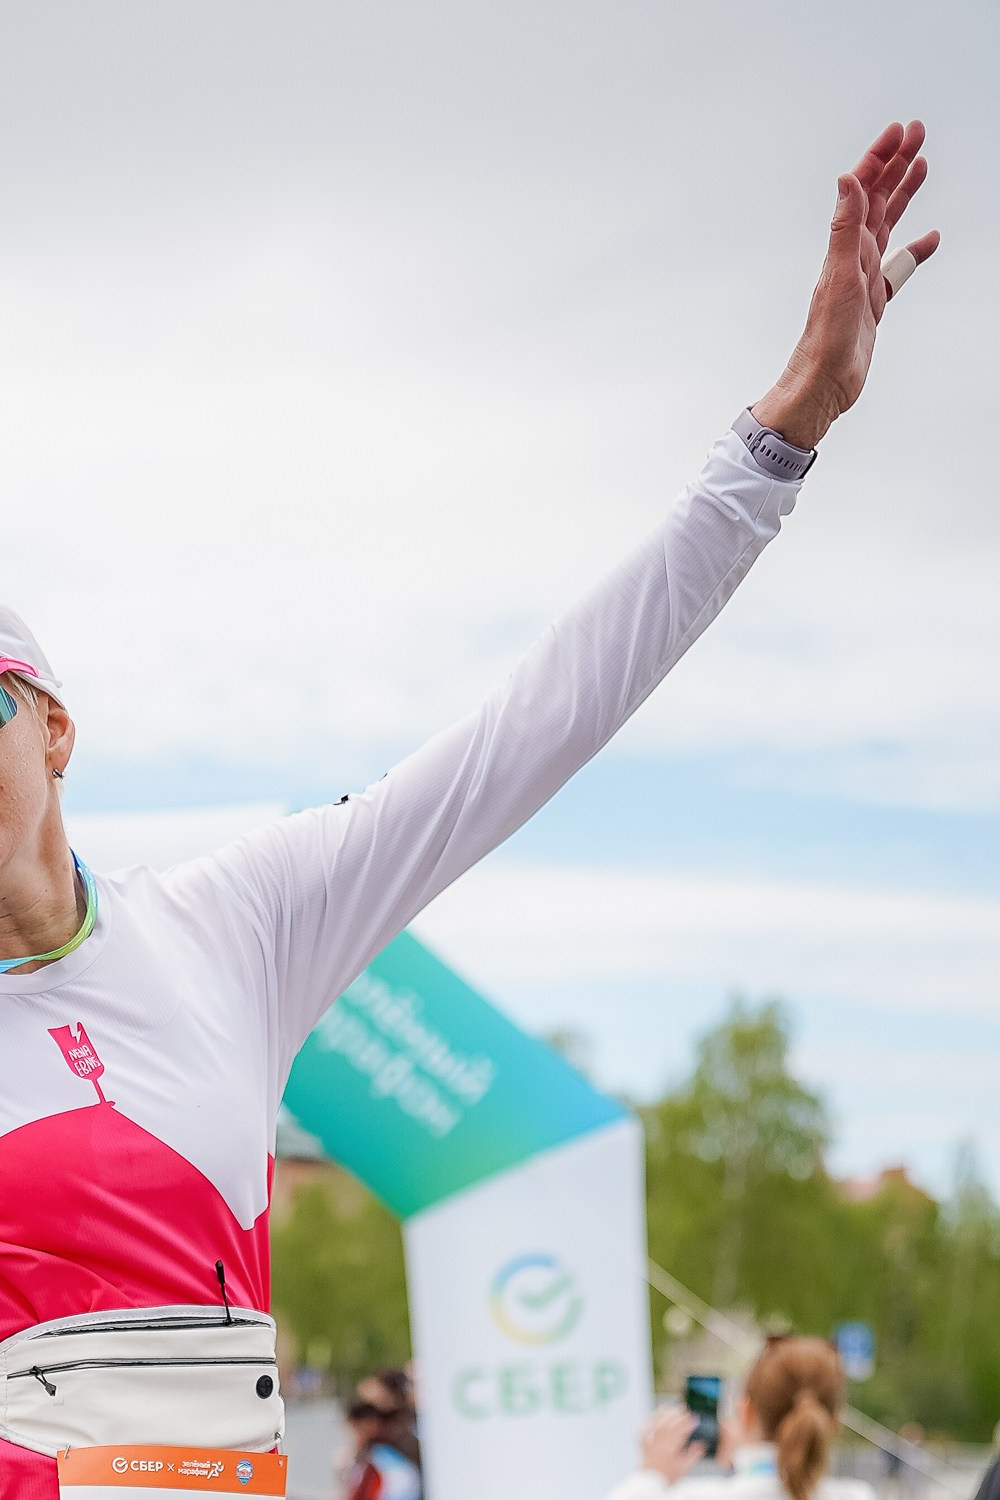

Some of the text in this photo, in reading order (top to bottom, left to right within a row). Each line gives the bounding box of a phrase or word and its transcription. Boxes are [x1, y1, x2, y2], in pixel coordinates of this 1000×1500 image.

[452, 1362, 625, 1417] СБЕР
[130, 1460, 163, 1472] СБЕР
[181, 1459, 211, 1469] зелёный
[177, 1467, 208, 1478] марафон
